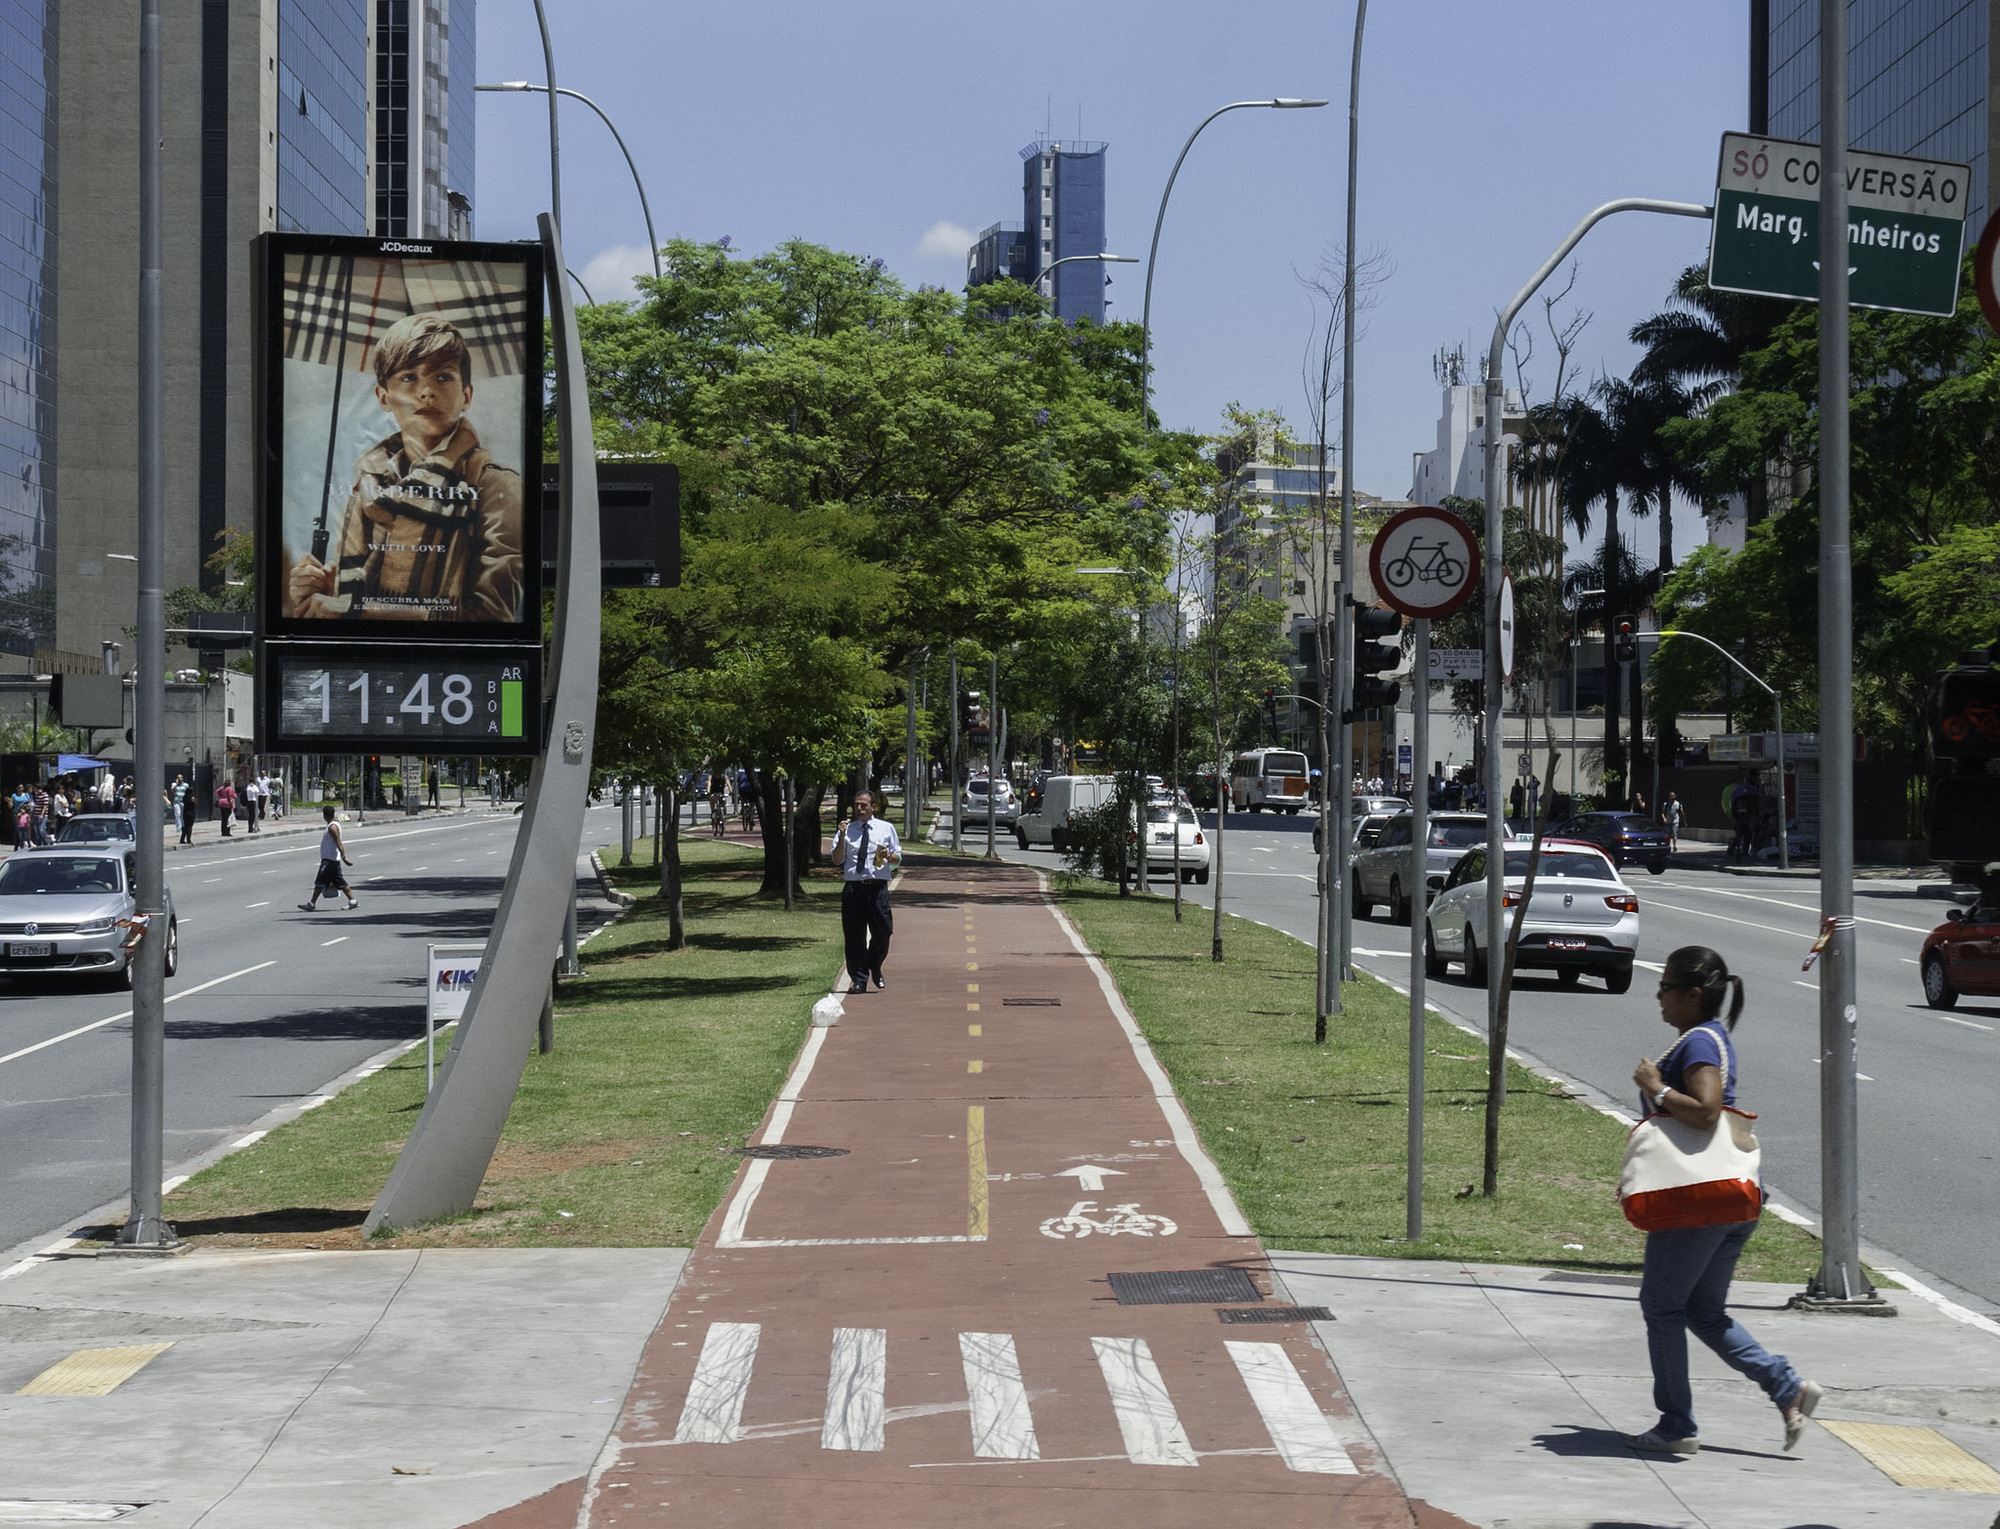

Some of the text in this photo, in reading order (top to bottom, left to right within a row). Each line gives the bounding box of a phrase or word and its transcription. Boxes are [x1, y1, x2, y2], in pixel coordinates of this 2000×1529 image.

[1732, 144, 1958, 204] SÓ COVERSÃO
[1736, 203, 1941, 255] Marg. nheiros
[379, 241, 433, 254] JCDecaux
[367, 543, 446, 553] WITH LOVE
[361, 596, 450, 605] DESCUBRA MAIS
[309, 667, 522, 725] 11:48 AR
[437, 969, 478, 985] KIK
